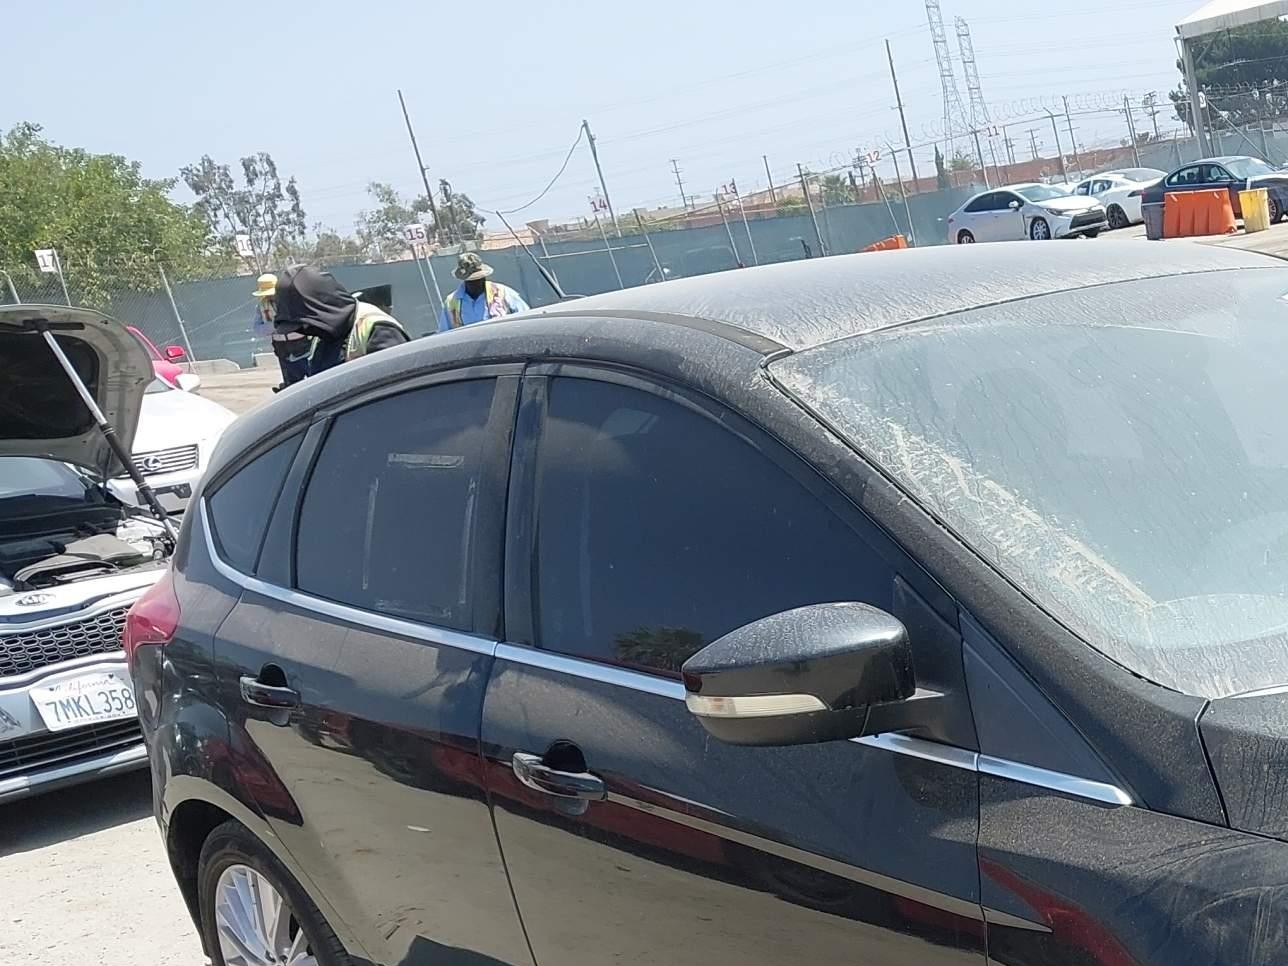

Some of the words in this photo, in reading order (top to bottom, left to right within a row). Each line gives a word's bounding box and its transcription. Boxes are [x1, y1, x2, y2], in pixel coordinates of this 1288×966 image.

[866, 150, 882, 164] 12
[721, 182, 738, 195] 13
[590, 199, 608, 213] 14
[406, 227, 425, 241] 15
[45, 688, 135, 723] 7MKL358
